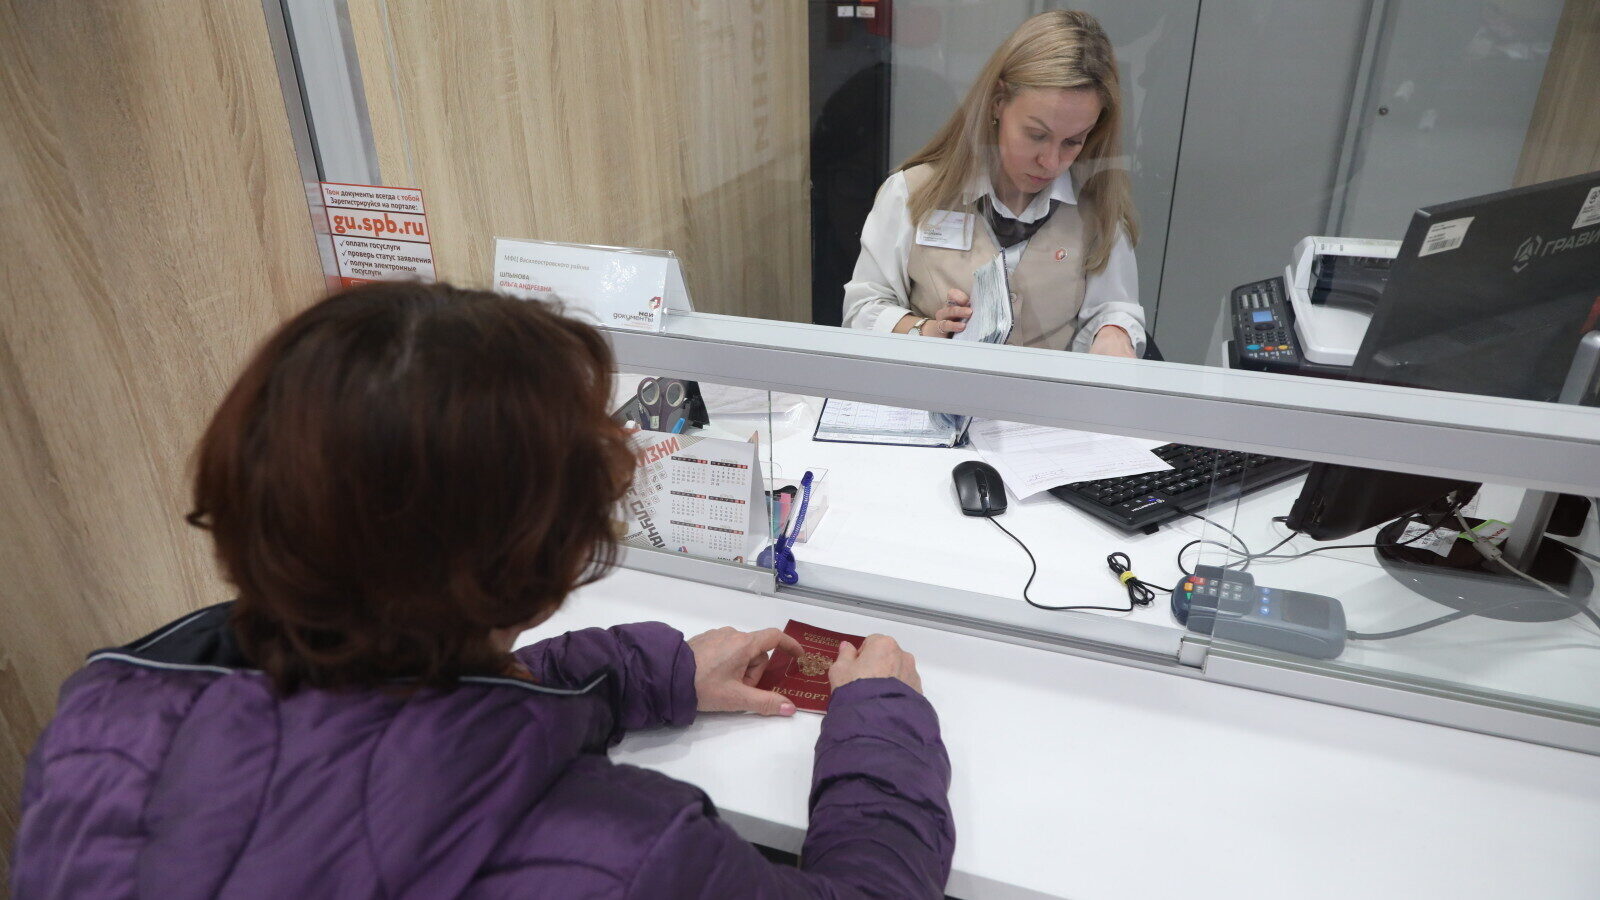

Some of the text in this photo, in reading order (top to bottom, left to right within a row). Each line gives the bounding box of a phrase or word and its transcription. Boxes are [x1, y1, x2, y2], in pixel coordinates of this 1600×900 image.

[325, 188, 340, 196] Твои
[340, 190, 375, 199] документы
[375, 193, 396, 201] всегда
[401, 194, 420, 203] тобой
[330, 196, 419, 211] Зарегистрируйся на портале:
[333, 213, 425, 237] gu.spb.ru
[345, 240, 401, 252] оплати госуслуги
[347, 250, 432, 265] проверь статус заявления
[503, 254, 590, 272] МФЦ Василеостровского района
[349, 260, 417, 273] получи электронные
[351, 268, 383, 277] госуслуги
[499, 280, 552, 293] ОЛЬГА АНДРЕЕВНА
[612, 312, 654, 323] документы
[637, 436, 680, 468] ИЗНИ
[772, 686, 829, 701] ПАСПОРТ
